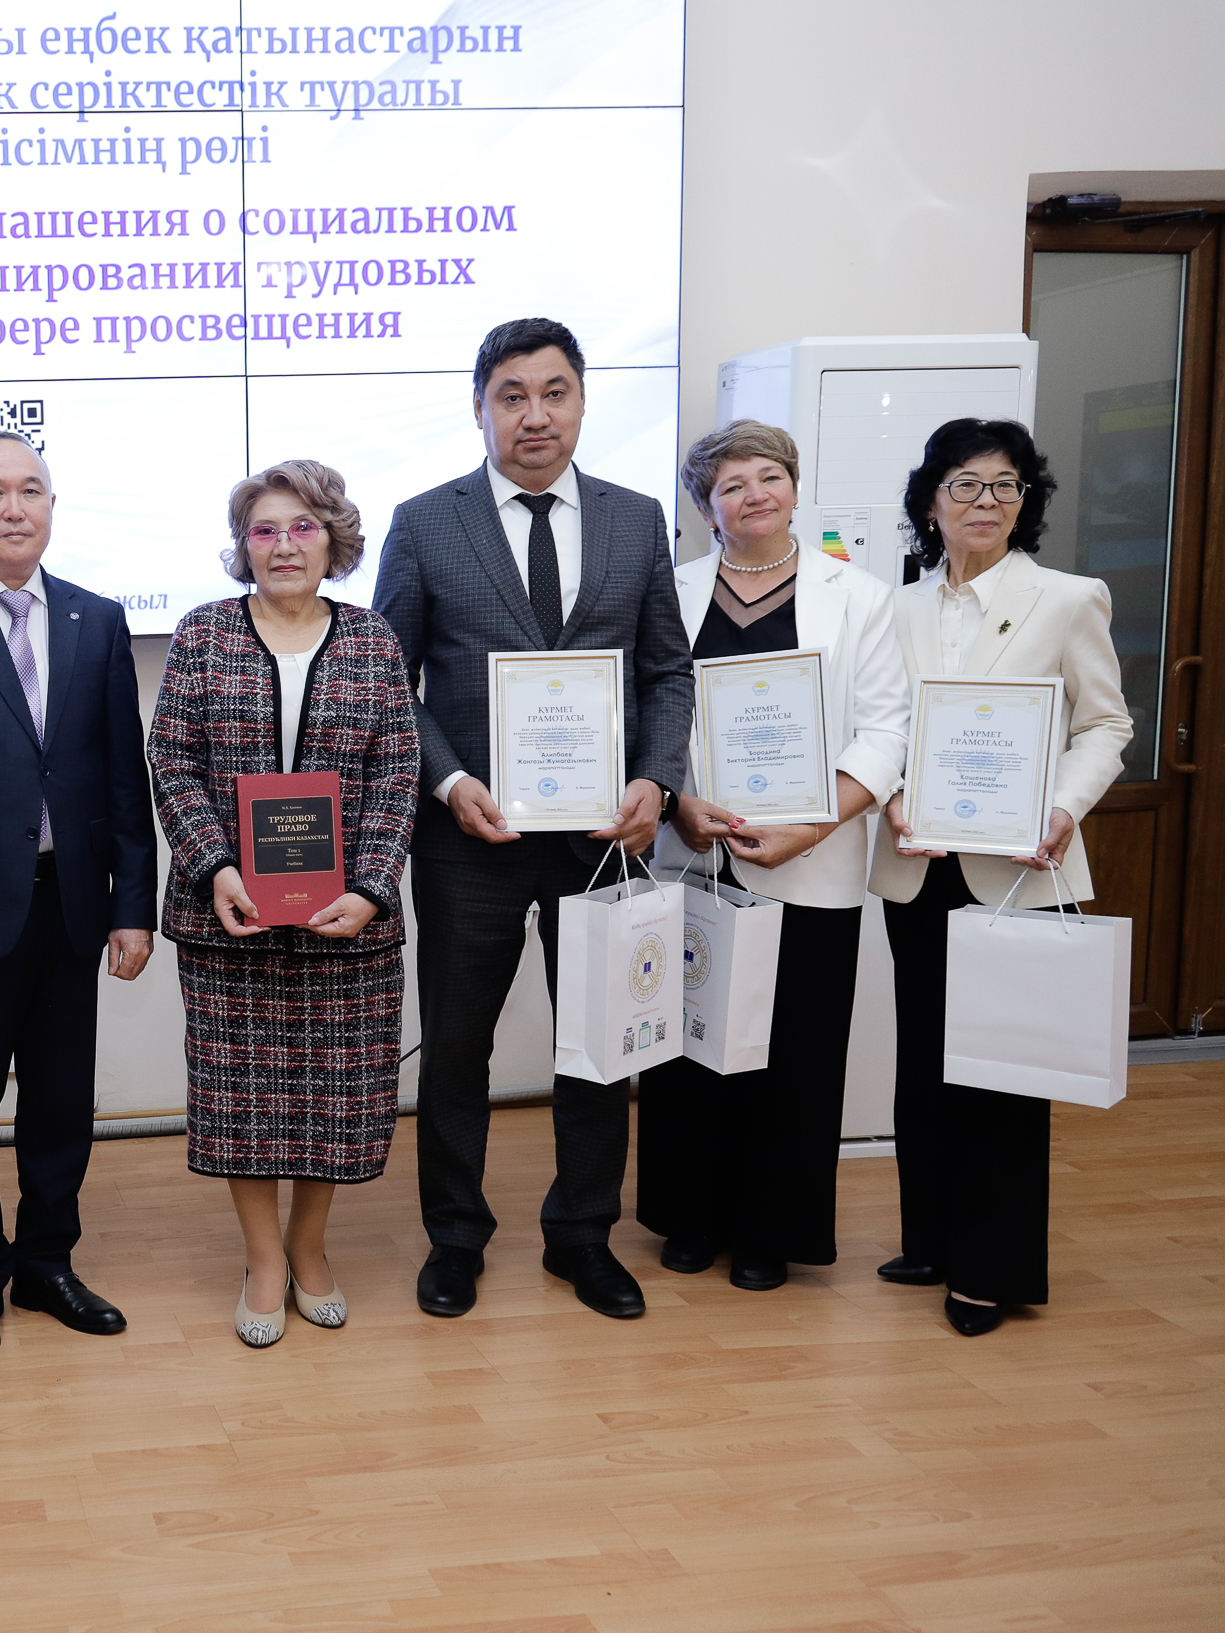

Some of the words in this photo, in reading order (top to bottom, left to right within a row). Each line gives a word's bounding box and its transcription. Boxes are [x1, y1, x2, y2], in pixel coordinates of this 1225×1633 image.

[40, 20, 172, 64] еңбек
[184, 18, 523, 64] қатынастарын
[29, 70, 290, 121] серіктестік
[300, 73, 463, 119] туралы
[178, 126, 272, 174] рөлі
[203, 208, 226, 237] о
[239, 202, 518, 241] социальном
[256, 253, 476, 298] трудовых
[93, 306, 403, 348] просвещения
[114, 594, 168, 610] жыл
[527, 714, 585, 722] ГРАМОТАСЫ
[734, 712, 792, 723] ГРАМОТАСЫ
[950, 738, 1013, 747] ГРАМОТАСЫ
[268, 815, 317, 823] ТРУДОВОЕ
[277, 823, 309, 832] ПРАВО
